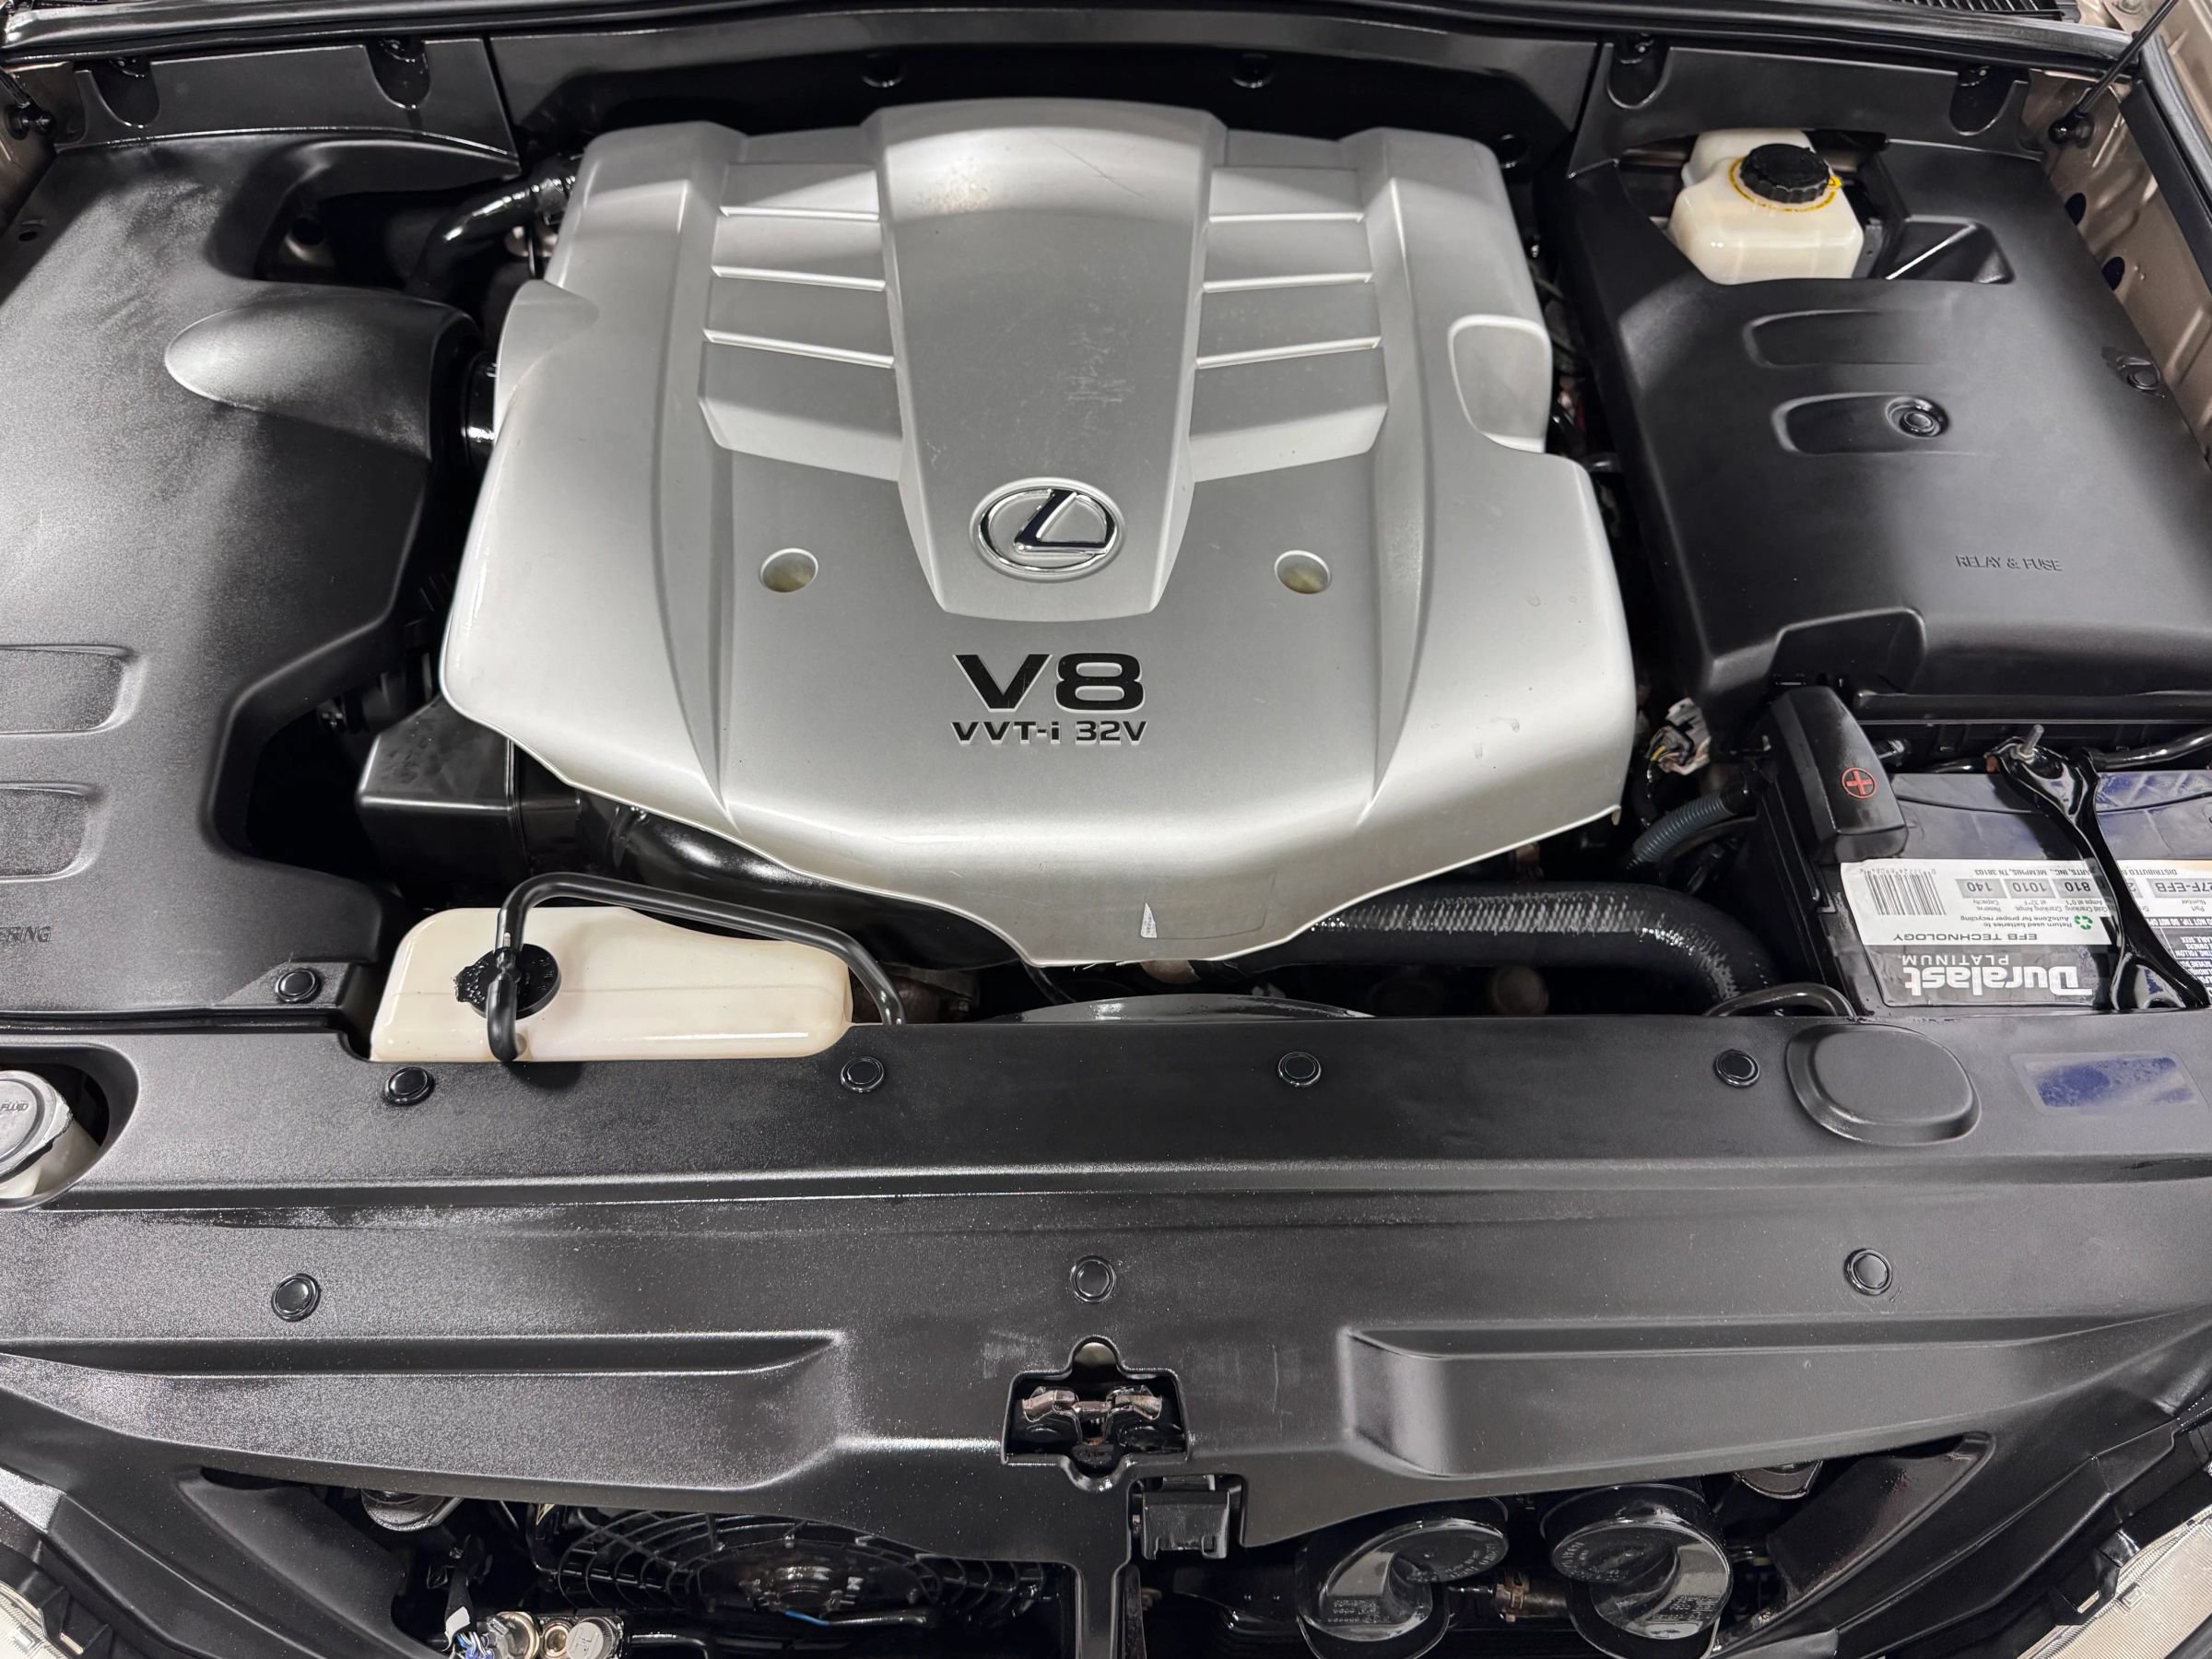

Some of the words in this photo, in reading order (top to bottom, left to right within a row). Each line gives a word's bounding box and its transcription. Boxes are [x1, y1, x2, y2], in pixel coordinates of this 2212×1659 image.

[1955, 555, 2001, 569] RELAY
[2006, 557, 2021, 570] &
[2022, 558, 2064, 571] FUSE
[953, 653, 1146, 714] V8
[951, 721, 1061, 745] VVT-i
[1075, 720, 1147, 745] 32V
[1966, 882, 1993, 893] 140
[2012, 882, 2047, 893] 1010
[2064, 882, 2091, 893] 810
[1893, 933, 2002, 941] TECHNOLOGY
[1901, 955, 2009, 966] PLATINUM
[1902, 965, 2093, 996] Duralast
